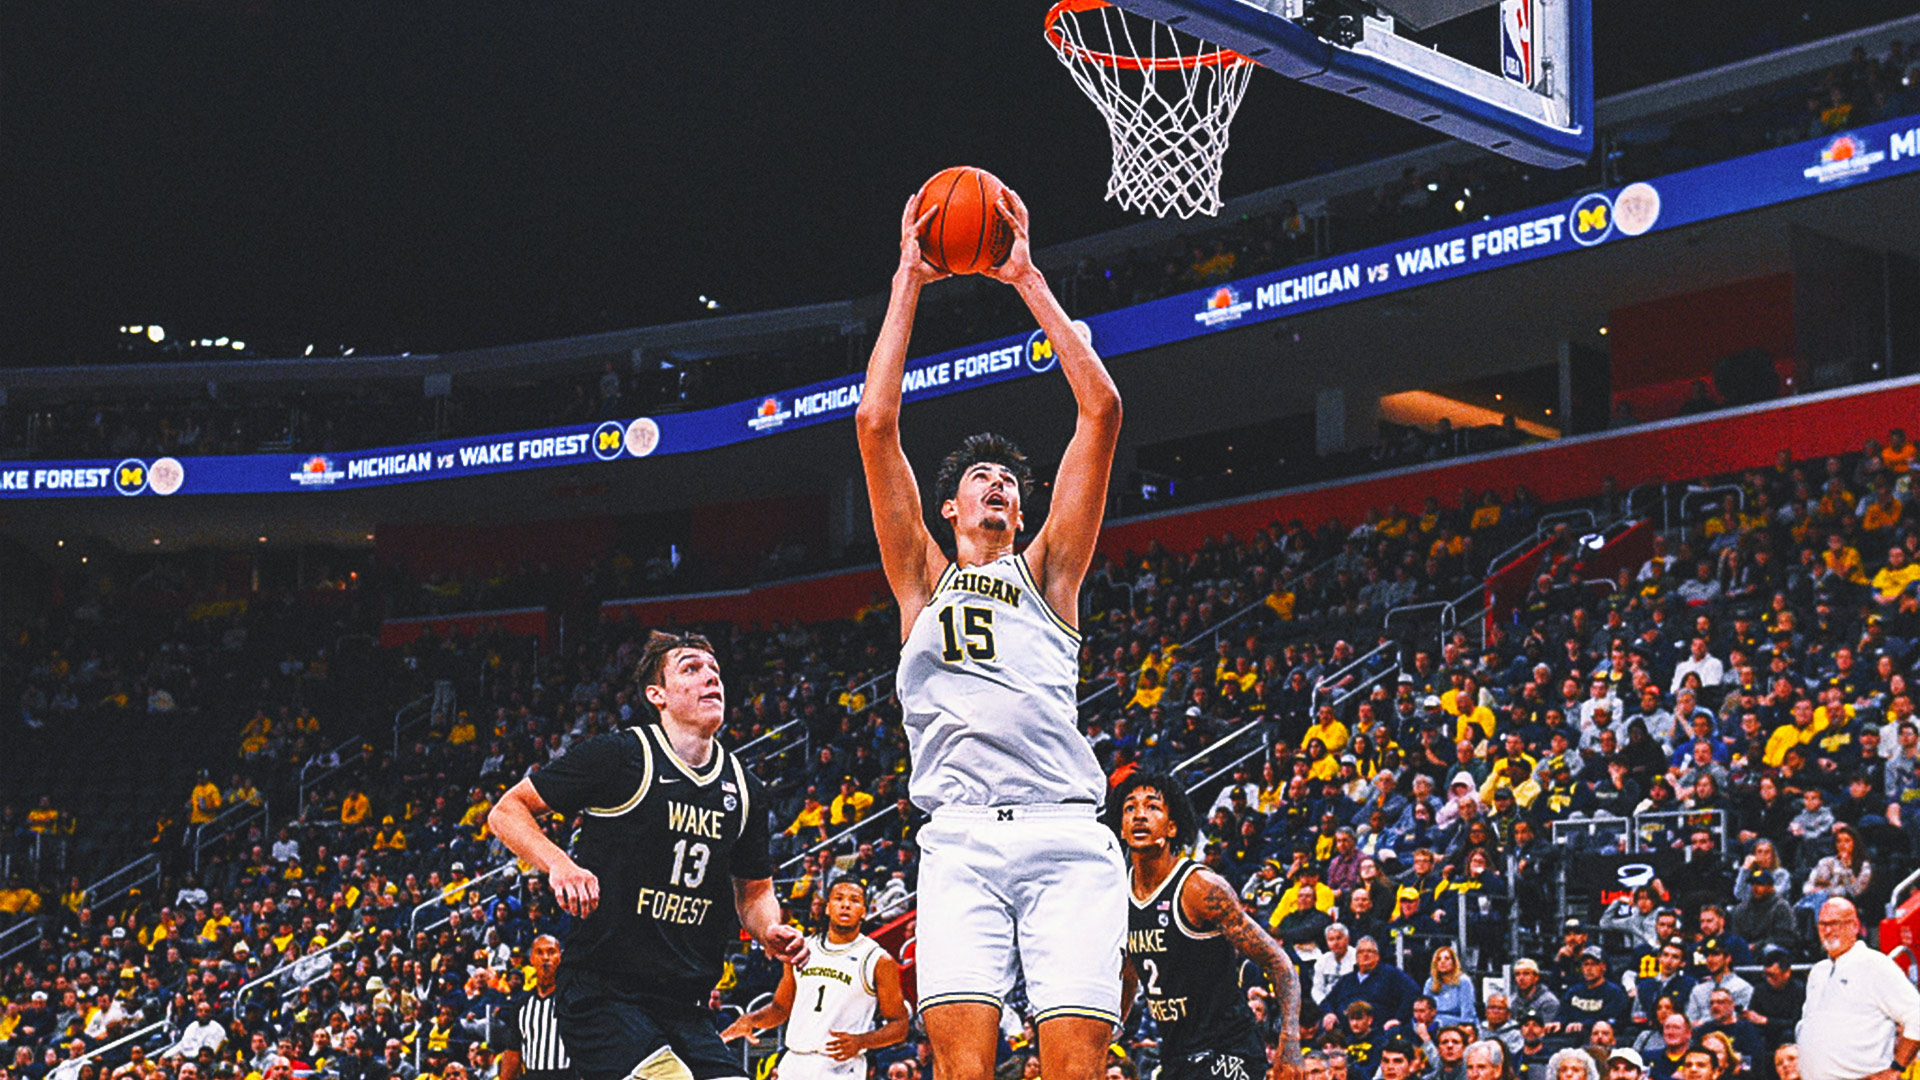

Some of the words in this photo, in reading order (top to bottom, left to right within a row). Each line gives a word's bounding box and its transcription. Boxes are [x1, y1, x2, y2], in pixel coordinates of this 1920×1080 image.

[1256, 264, 1360, 310] MICHIGAN
[1396, 243, 1466, 277] WAKE
[1472, 214, 1566, 260] FOREST
[1578, 205, 1607, 233] M
[794, 383, 864, 418] MICHIGA
[954, 345, 1024, 381] FOREST
[1032, 338, 1053, 361] M
[348, 452, 432, 479] MICHIGAN
[459, 443, 514, 467] WAKE
[519, 433, 590, 460] FOREST
[599, 430, 620, 450] M
[0, 470, 29, 489] KE
[34, 468, 111, 489] FOREST
[120, 467, 143, 486] M
[948, 573, 1021, 608] HIGAN
[938, 605, 995, 663] 15
[667, 800, 725, 840] WAKE
[997, 809, 1014, 821] M
[669, 839, 711, 889] 13
[636, 887, 713, 926] FOREST
[1128, 928, 1168, 954] WAKE
[1142, 958, 1163, 995] 2
[813, 984, 826, 1012] 1
